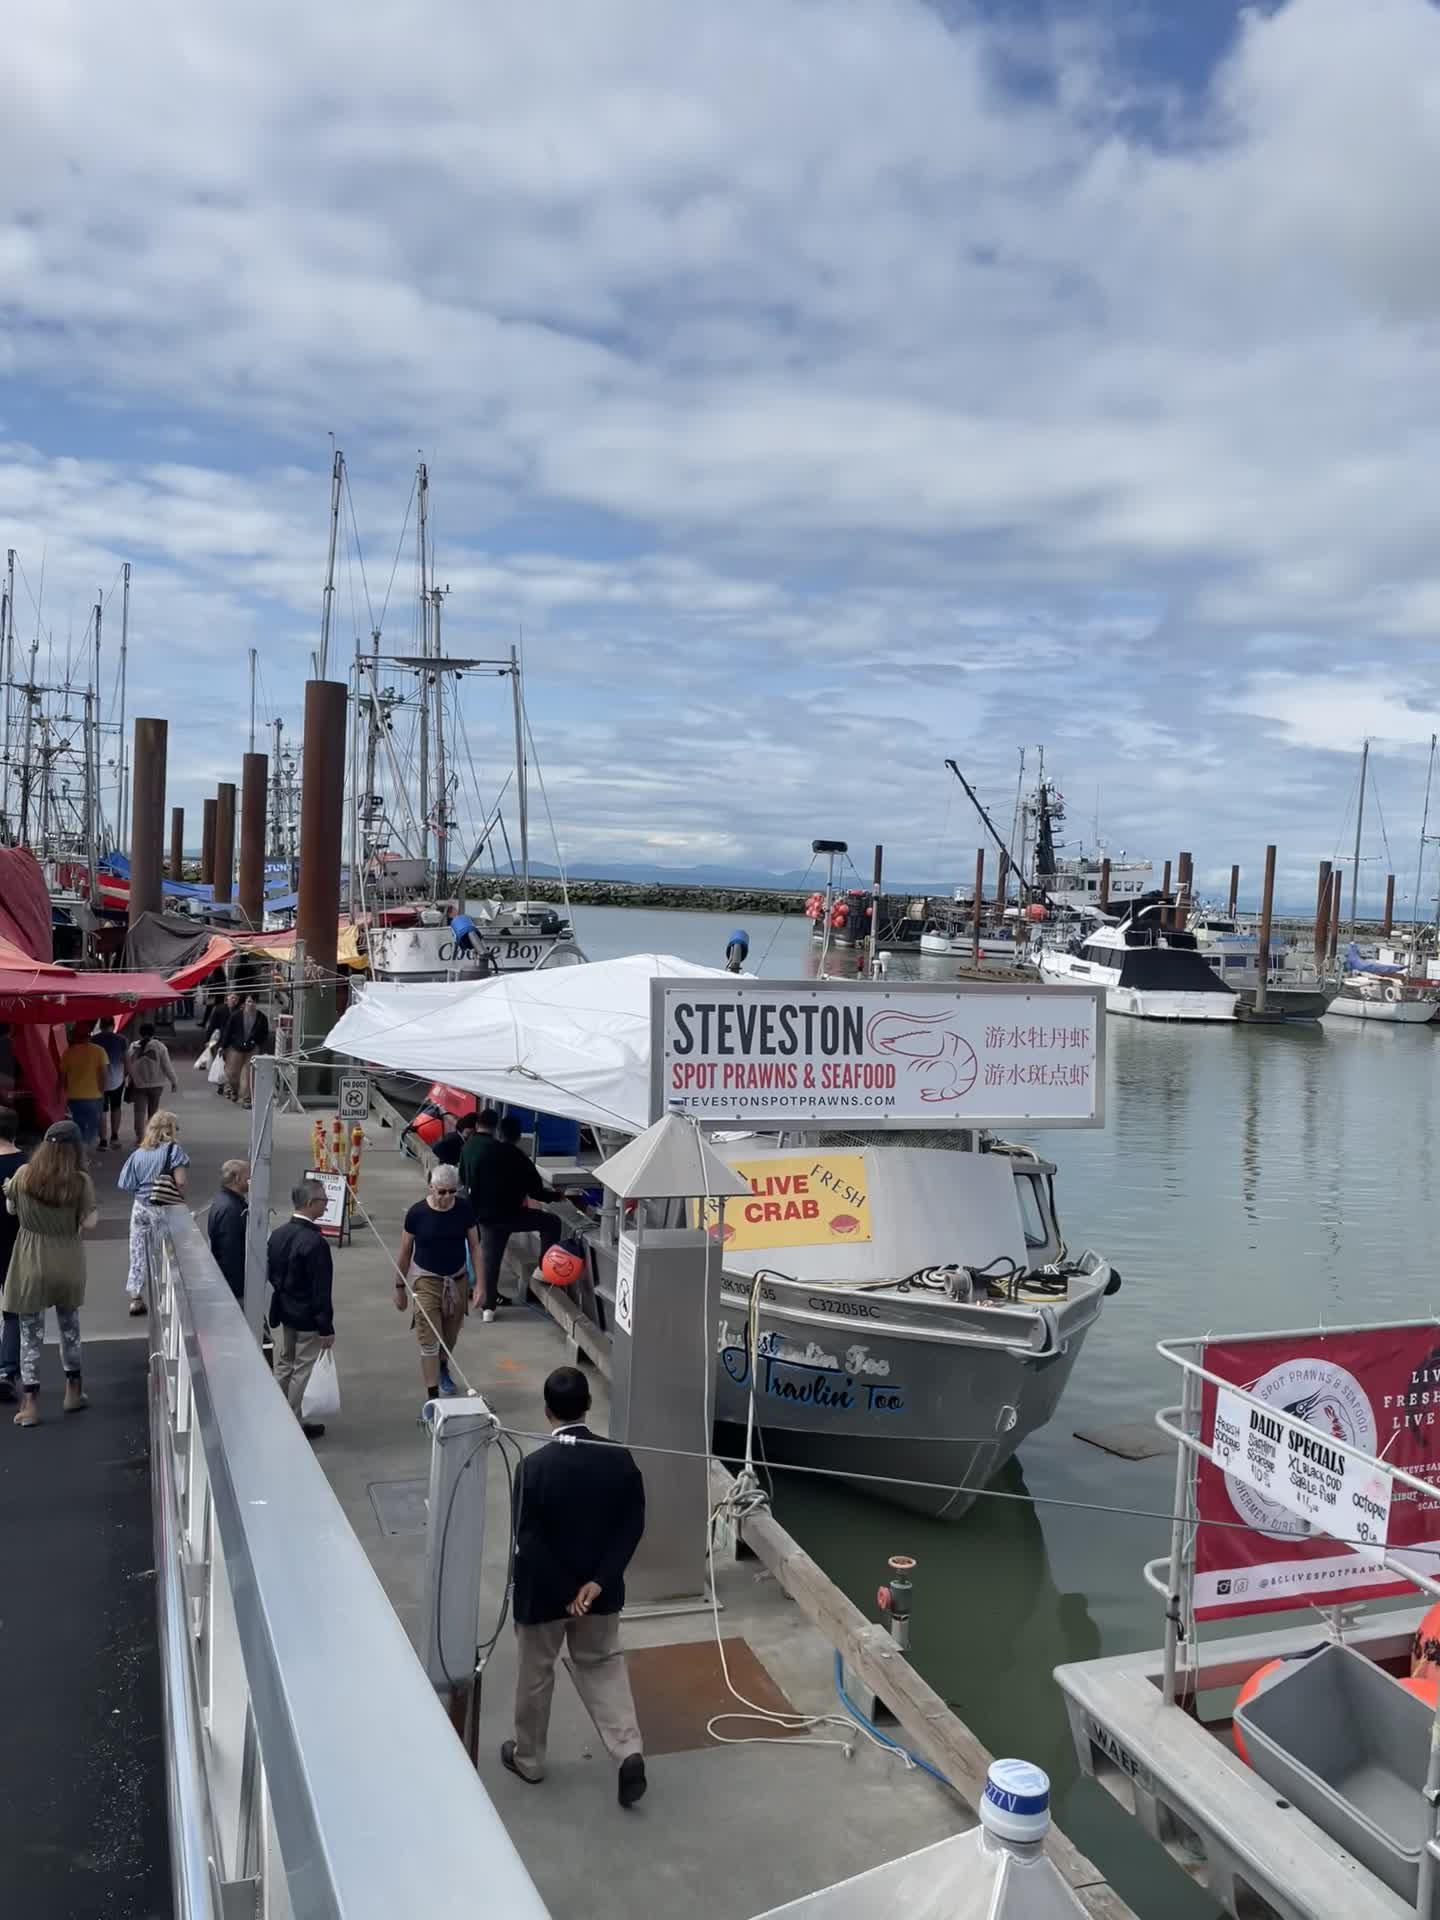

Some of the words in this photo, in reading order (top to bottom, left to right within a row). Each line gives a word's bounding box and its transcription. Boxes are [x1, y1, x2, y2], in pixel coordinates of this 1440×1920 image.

[505, 941, 542, 963] Boy
[673, 1003, 864, 1056] STEVESTON
[984, 1025, 1089, 1049] 游水牡丹虾
[343, 1081, 351, 1089] NO
[352, 1081, 366, 1089] DOGS
[672, 1063, 716, 1090] SPOT
[723, 1063, 797, 1090] PRAWNS
[803, 1064, 815, 1089] &
[821, 1063, 896, 1090] SEAFOOD
[984, 1063, 1089, 1087] 游水斑点虾
[341, 1109, 366, 1117] ALLOWED
[681, 1095, 896, 1107] TEVESTONSPOTPRAWNS.COM
[751, 1175, 809, 1196] LIVE
[810, 1163, 867, 1208] FRESH
[744, 1199, 820, 1223] CRAB
[808, 1297, 881, 1319] C32205BC
[861, 1383, 905, 1411] Too
[1261, 1376, 1286, 1400] SPOT
[1289, 1369, 1332, 1385] PRAWNS
[1333, 1379, 1342, 1389] &
[1341, 1385, 1368, 1433] SEAFOOD
[1383, 1391, 1440, 1408] FRESH
[1392, 1412, 1435, 1429] LIVE
[1250, 1409, 1284, 1444] DAILY
[1287, 1429, 1345, 1476] SPECIALS
[1287, 1454, 1302, 1474] XL
[1326, 1474, 1342, 1491] COD
[1234, 1479, 1269, 1523] SHERMEN
